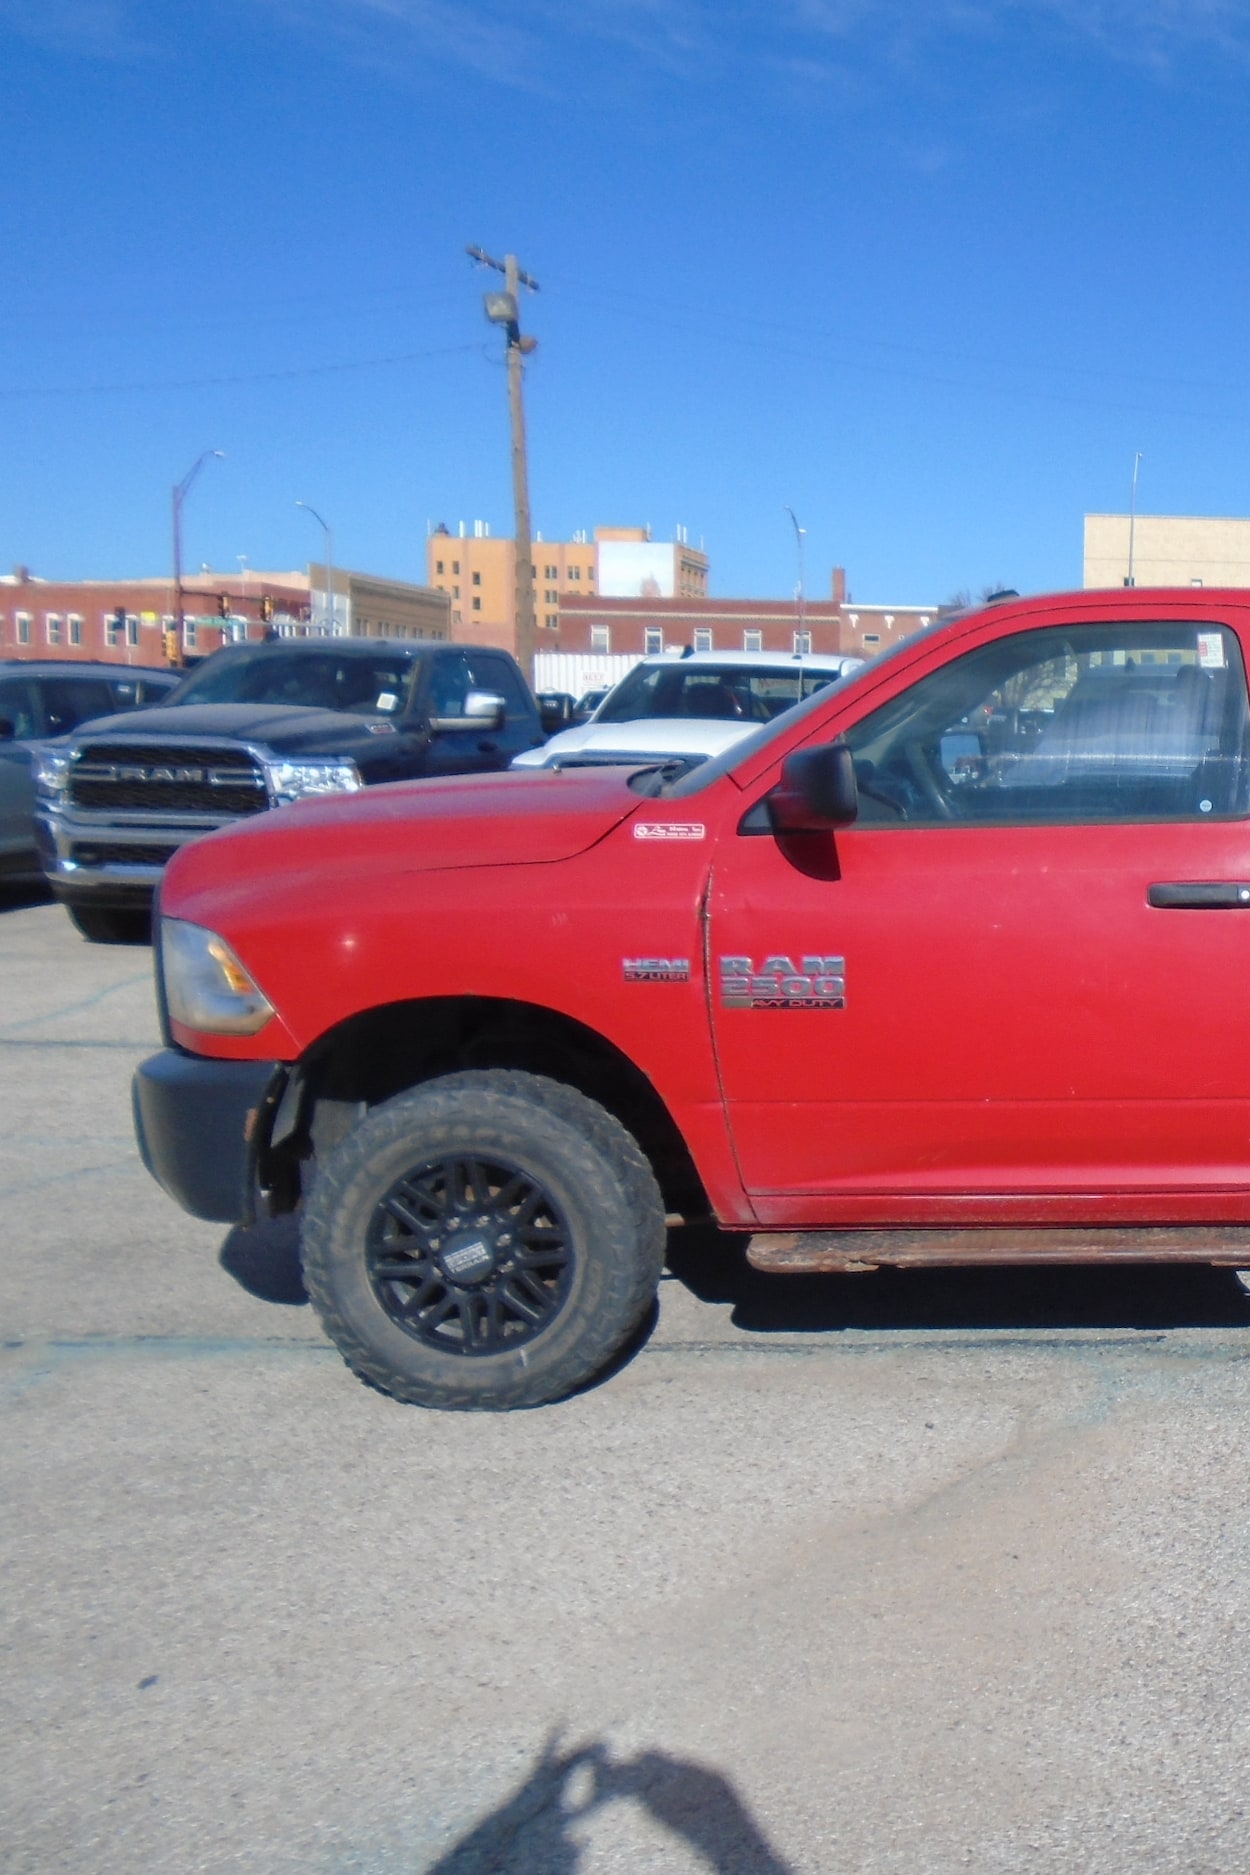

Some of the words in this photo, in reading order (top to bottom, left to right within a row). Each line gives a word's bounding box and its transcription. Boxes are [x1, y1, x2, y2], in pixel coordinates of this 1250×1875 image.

[119, 767, 202, 781] RAM
[622, 959, 689, 971] HEMI
[720, 956, 845, 976] RAM
[624, 972, 648, 980] 5.7
[650, 972, 688, 980] LITER
[721, 977, 845, 996] 2500
[789, 999, 840, 1007] DUTY
